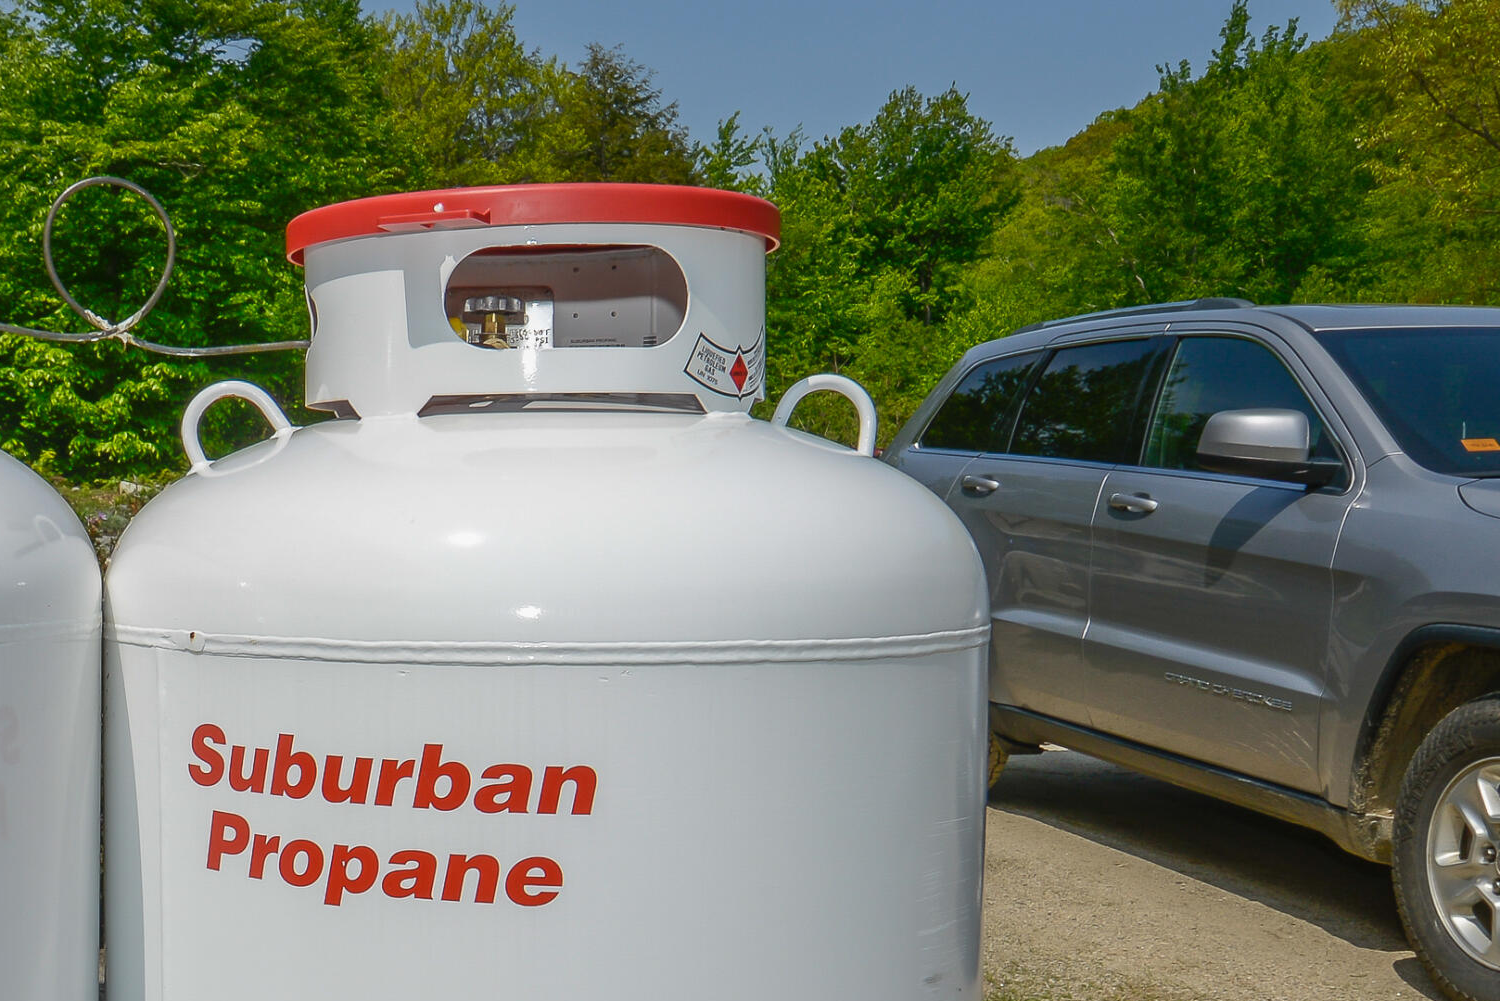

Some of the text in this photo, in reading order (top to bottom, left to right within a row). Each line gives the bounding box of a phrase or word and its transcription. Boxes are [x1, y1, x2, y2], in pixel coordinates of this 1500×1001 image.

[696, 351, 727, 373] PETROLEUM
[704, 364, 716, 375] GAS
[188, 723, 598, 815] Suburban
[208, 810, 564, 907] Propane
